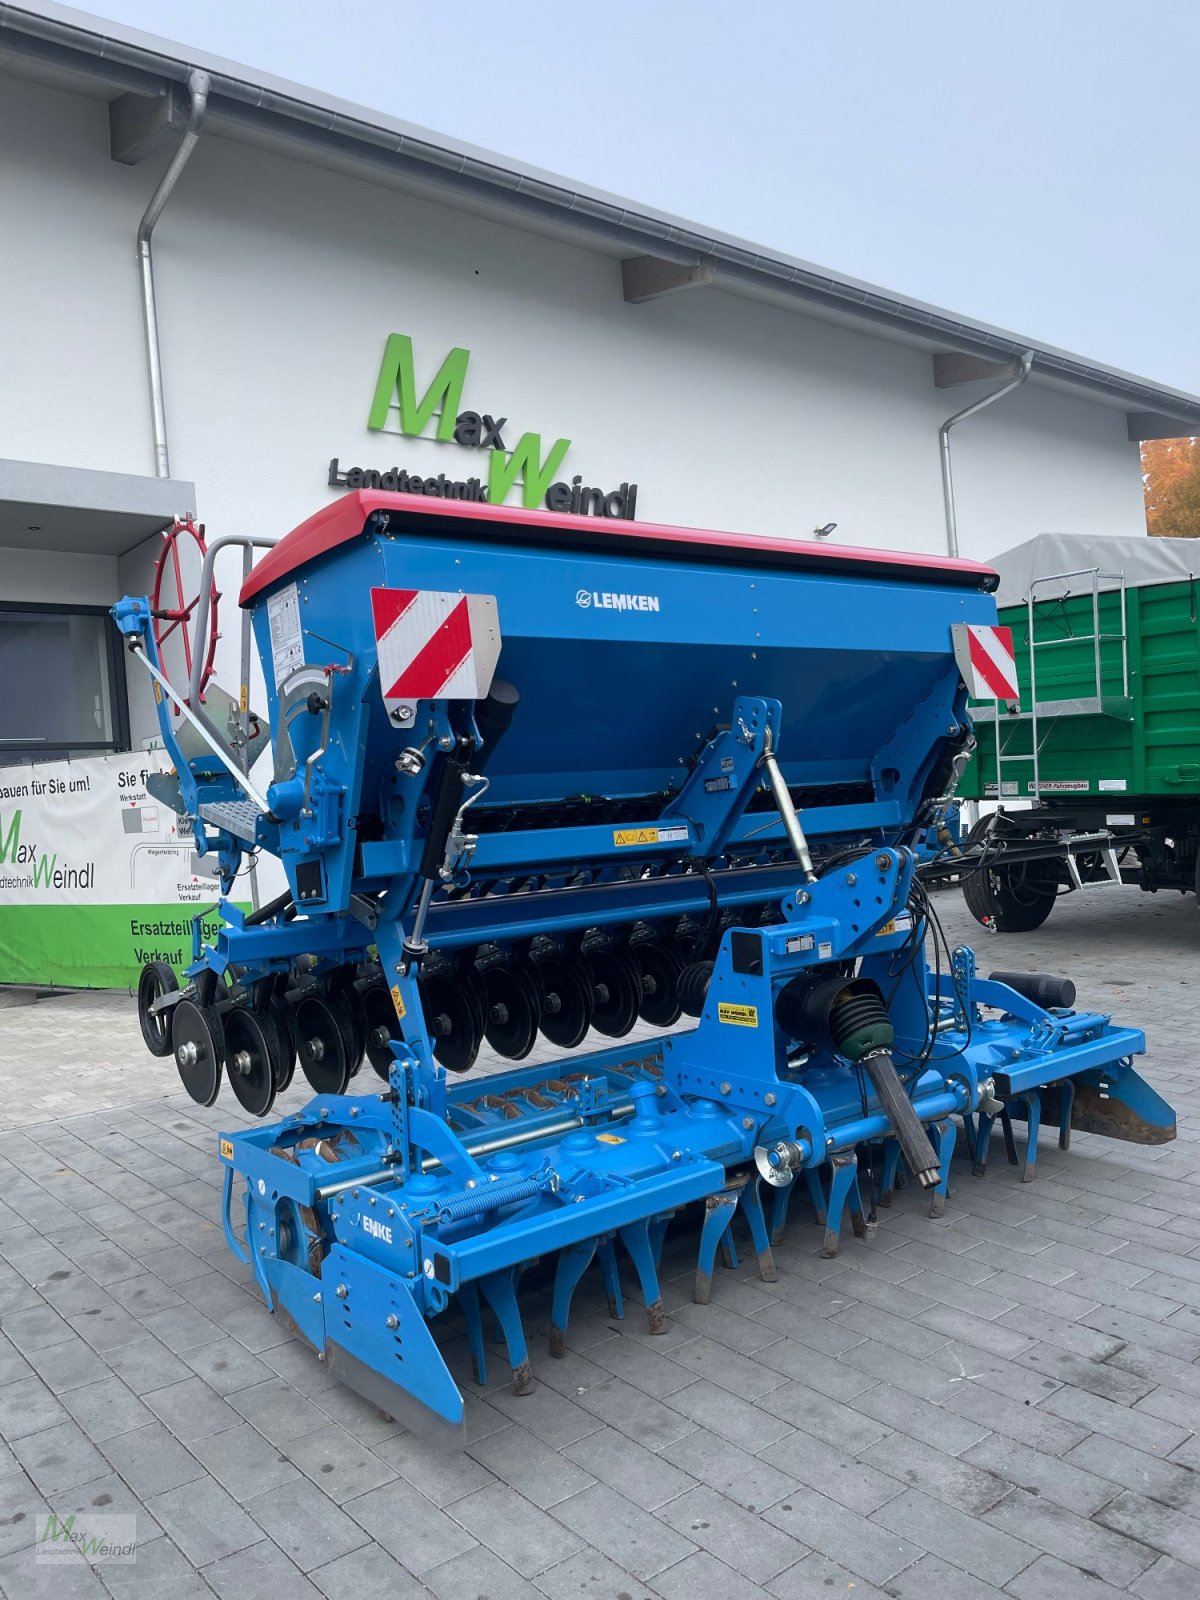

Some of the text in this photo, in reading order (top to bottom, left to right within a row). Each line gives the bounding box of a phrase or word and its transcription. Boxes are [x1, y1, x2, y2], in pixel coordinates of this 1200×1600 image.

[367, 332, 507, 450] Max
[328, 432, 638, 520] Landtechnik Weindl
[593, 592, 660, 613] LEMKEN
[31, 780, 47, 795] für
[49, 779, 66, 794] Sie
[69, 775, 91, 792] um!
[118, 772, 136, 787] Sie
[119, 793, 146, 802] Werkstatt
[33, 853, 94, 889] Weindl
[177, 883, 220, 891] Ersatzteillager
[134, 949, 183, 964] Verkauf
